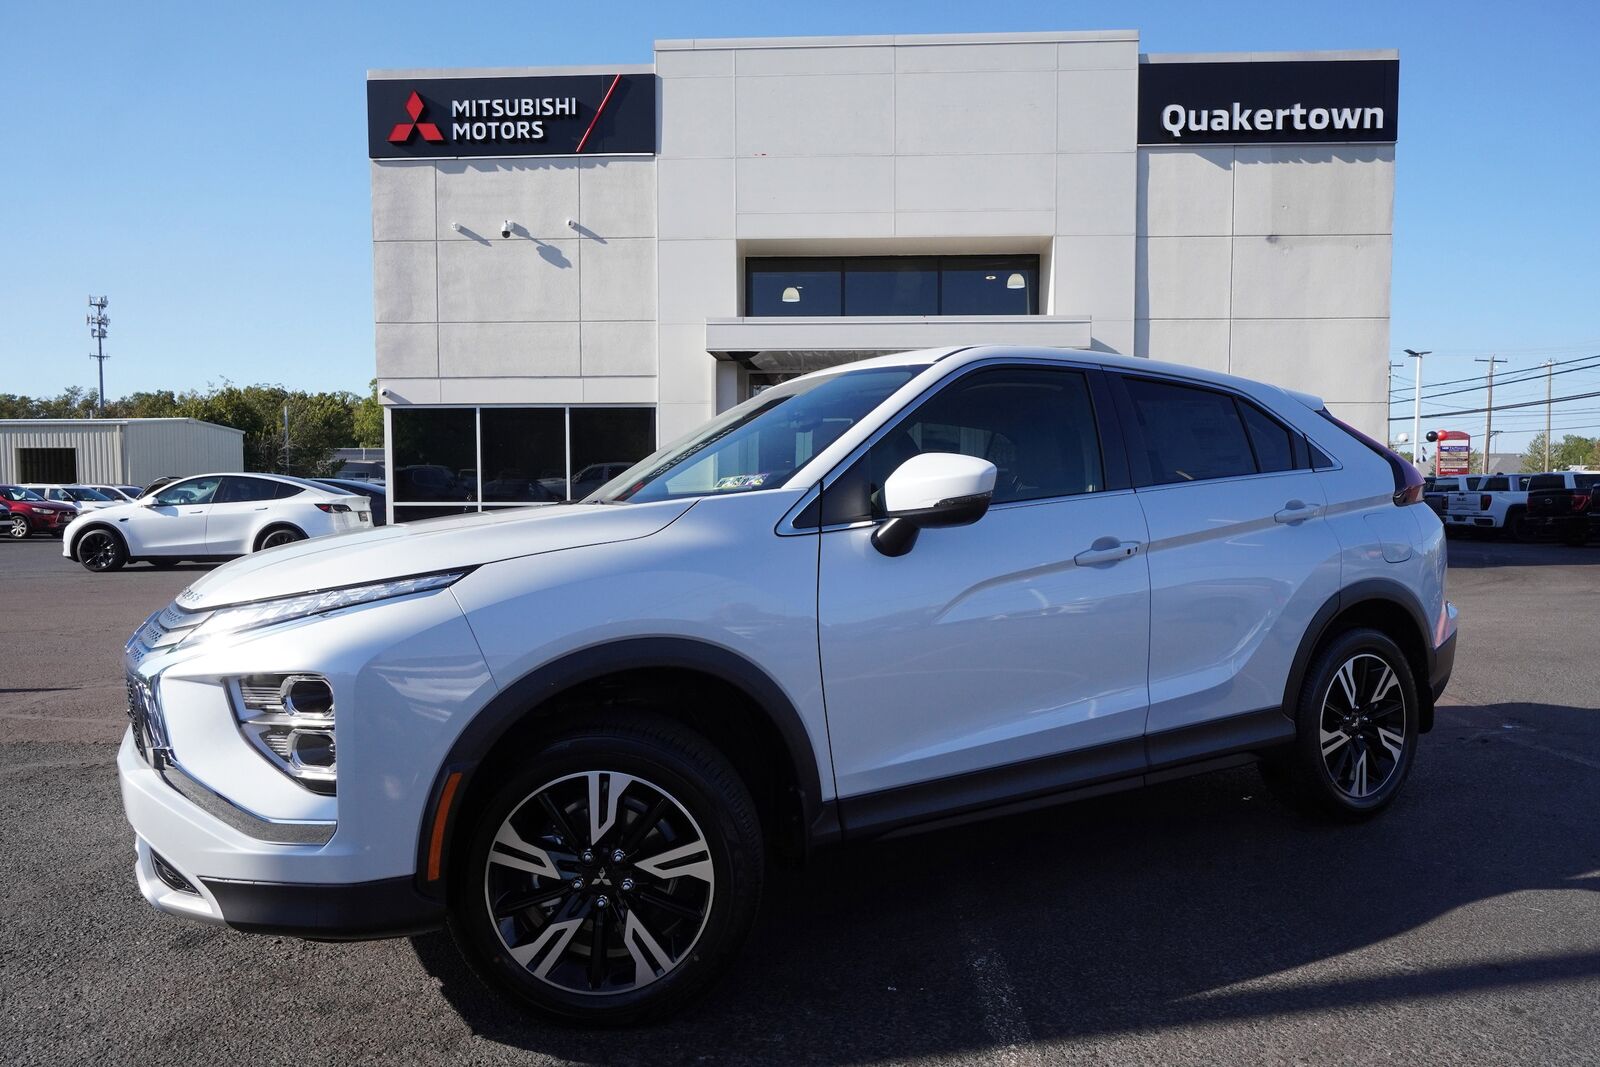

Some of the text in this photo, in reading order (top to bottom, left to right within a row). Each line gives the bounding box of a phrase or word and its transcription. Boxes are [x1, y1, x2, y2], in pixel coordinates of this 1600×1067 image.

[452, 97, 576, 118] MITSUBISHI
[1162, 102, 1384, 137] Quakertown
[452, 121, 544, 140] MOTORS
